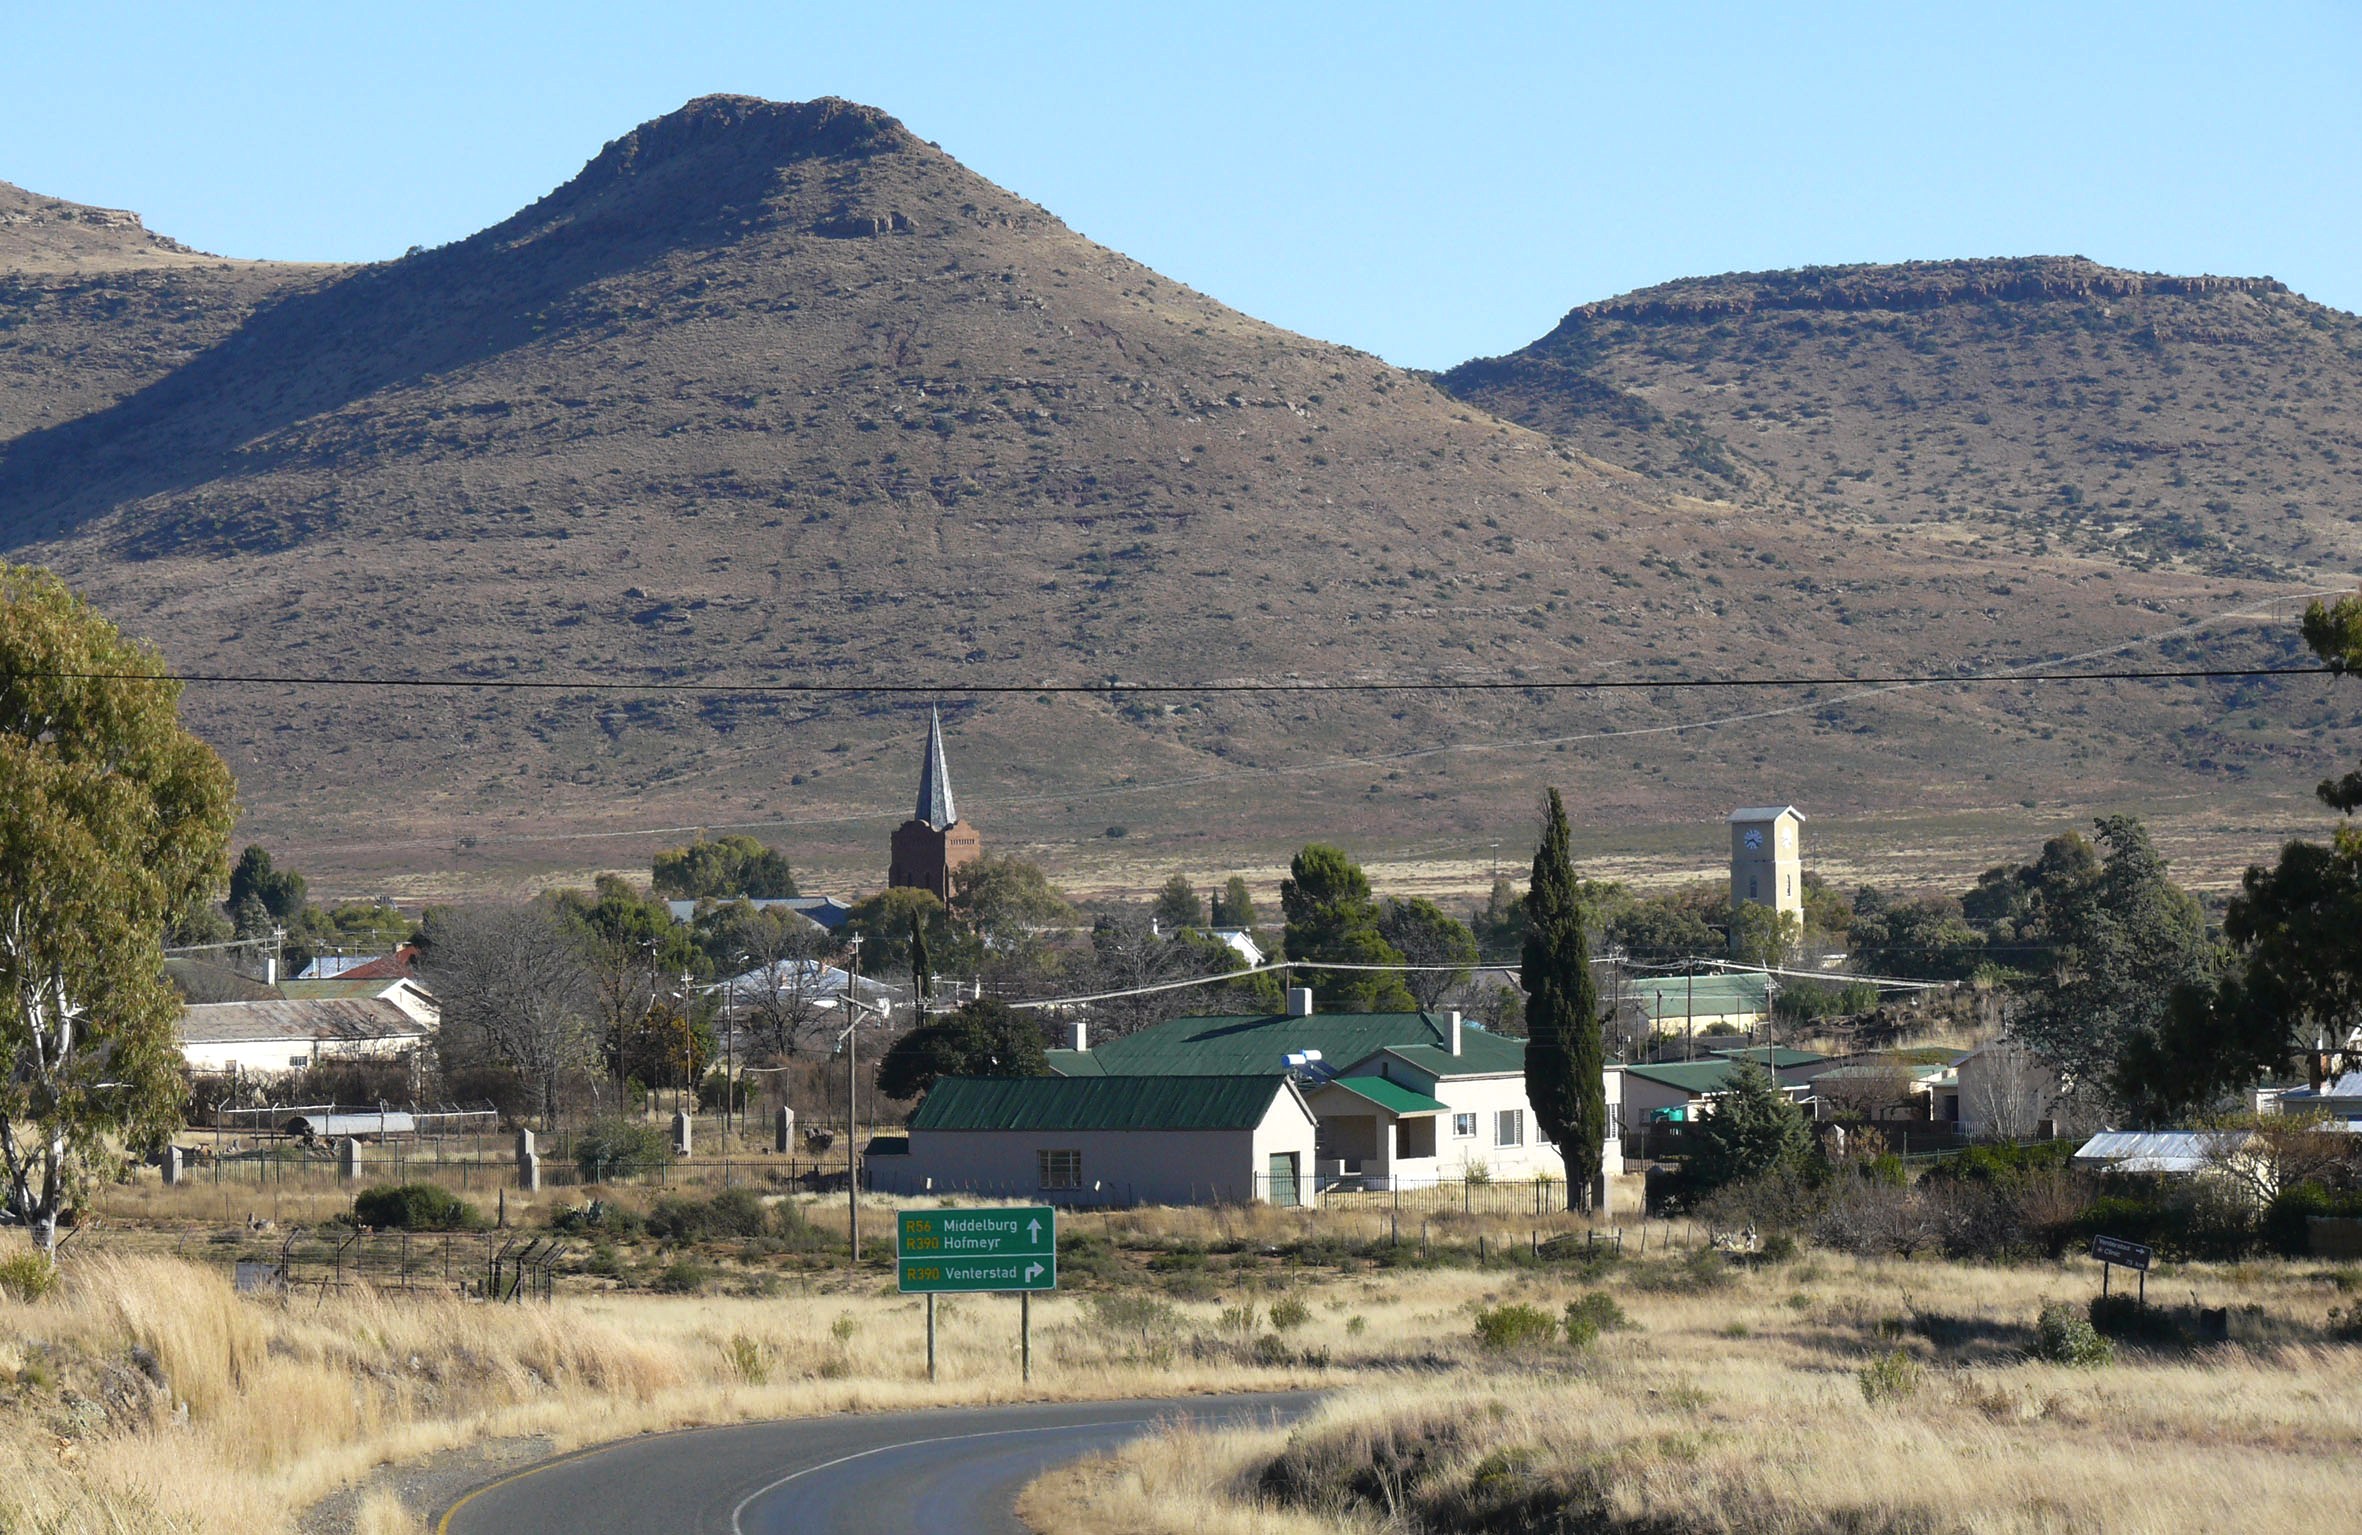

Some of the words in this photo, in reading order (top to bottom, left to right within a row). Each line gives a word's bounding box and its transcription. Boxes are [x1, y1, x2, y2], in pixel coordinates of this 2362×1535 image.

[906, 1220, 932, 1232] R56
[944, 1219, 1017, 1233] Middelburg
[906, 1237, 939, 1250] R390
[944, 1236, 1001, 1251] Hofmeyr
[907, 1267, 940, 1280] R390
[945, 1265, 1017, 1279] Venterstad
